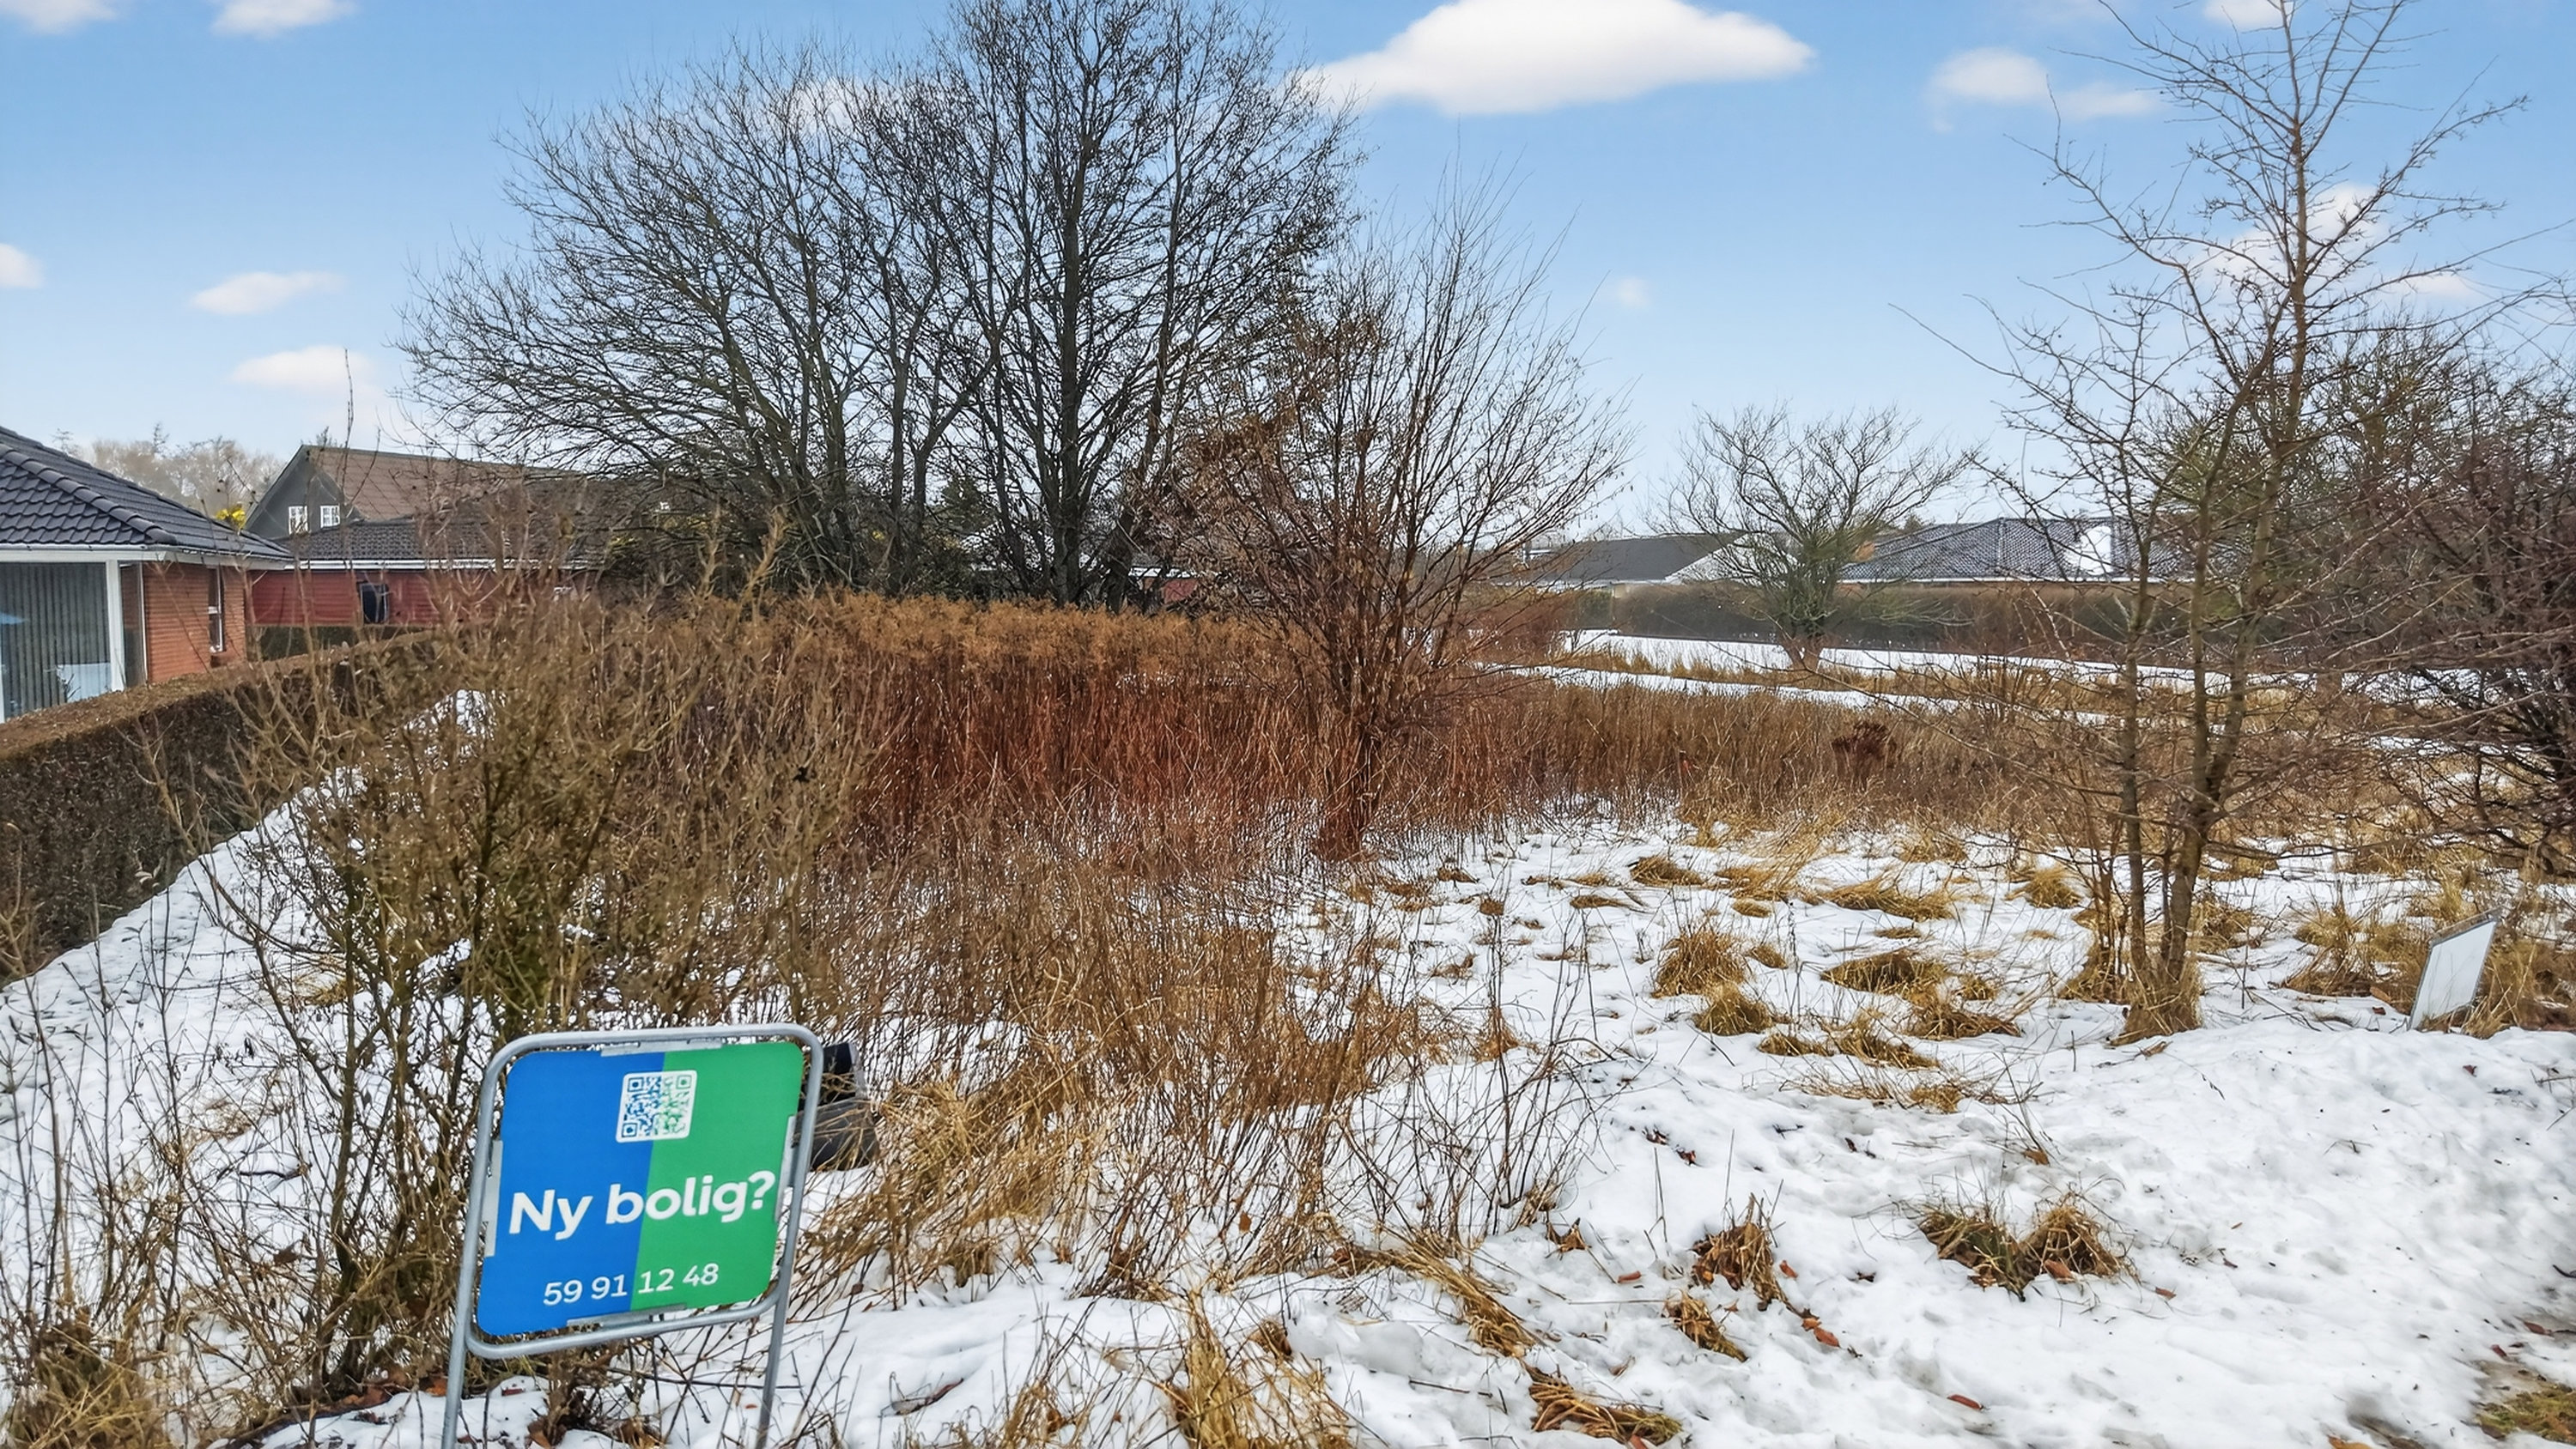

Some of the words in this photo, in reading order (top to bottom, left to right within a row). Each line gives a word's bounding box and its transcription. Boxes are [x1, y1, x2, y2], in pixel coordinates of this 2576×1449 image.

[509, 1190, 592, 1240] Ny
[605, 1171, 775, 1225] bolig?
[544, 1280, 583, 1306] 59
[591, 1274, 628, 1300] 91
[637, 1269, 674, 1294] 12
[682, 1263, 719, 1288] 48
